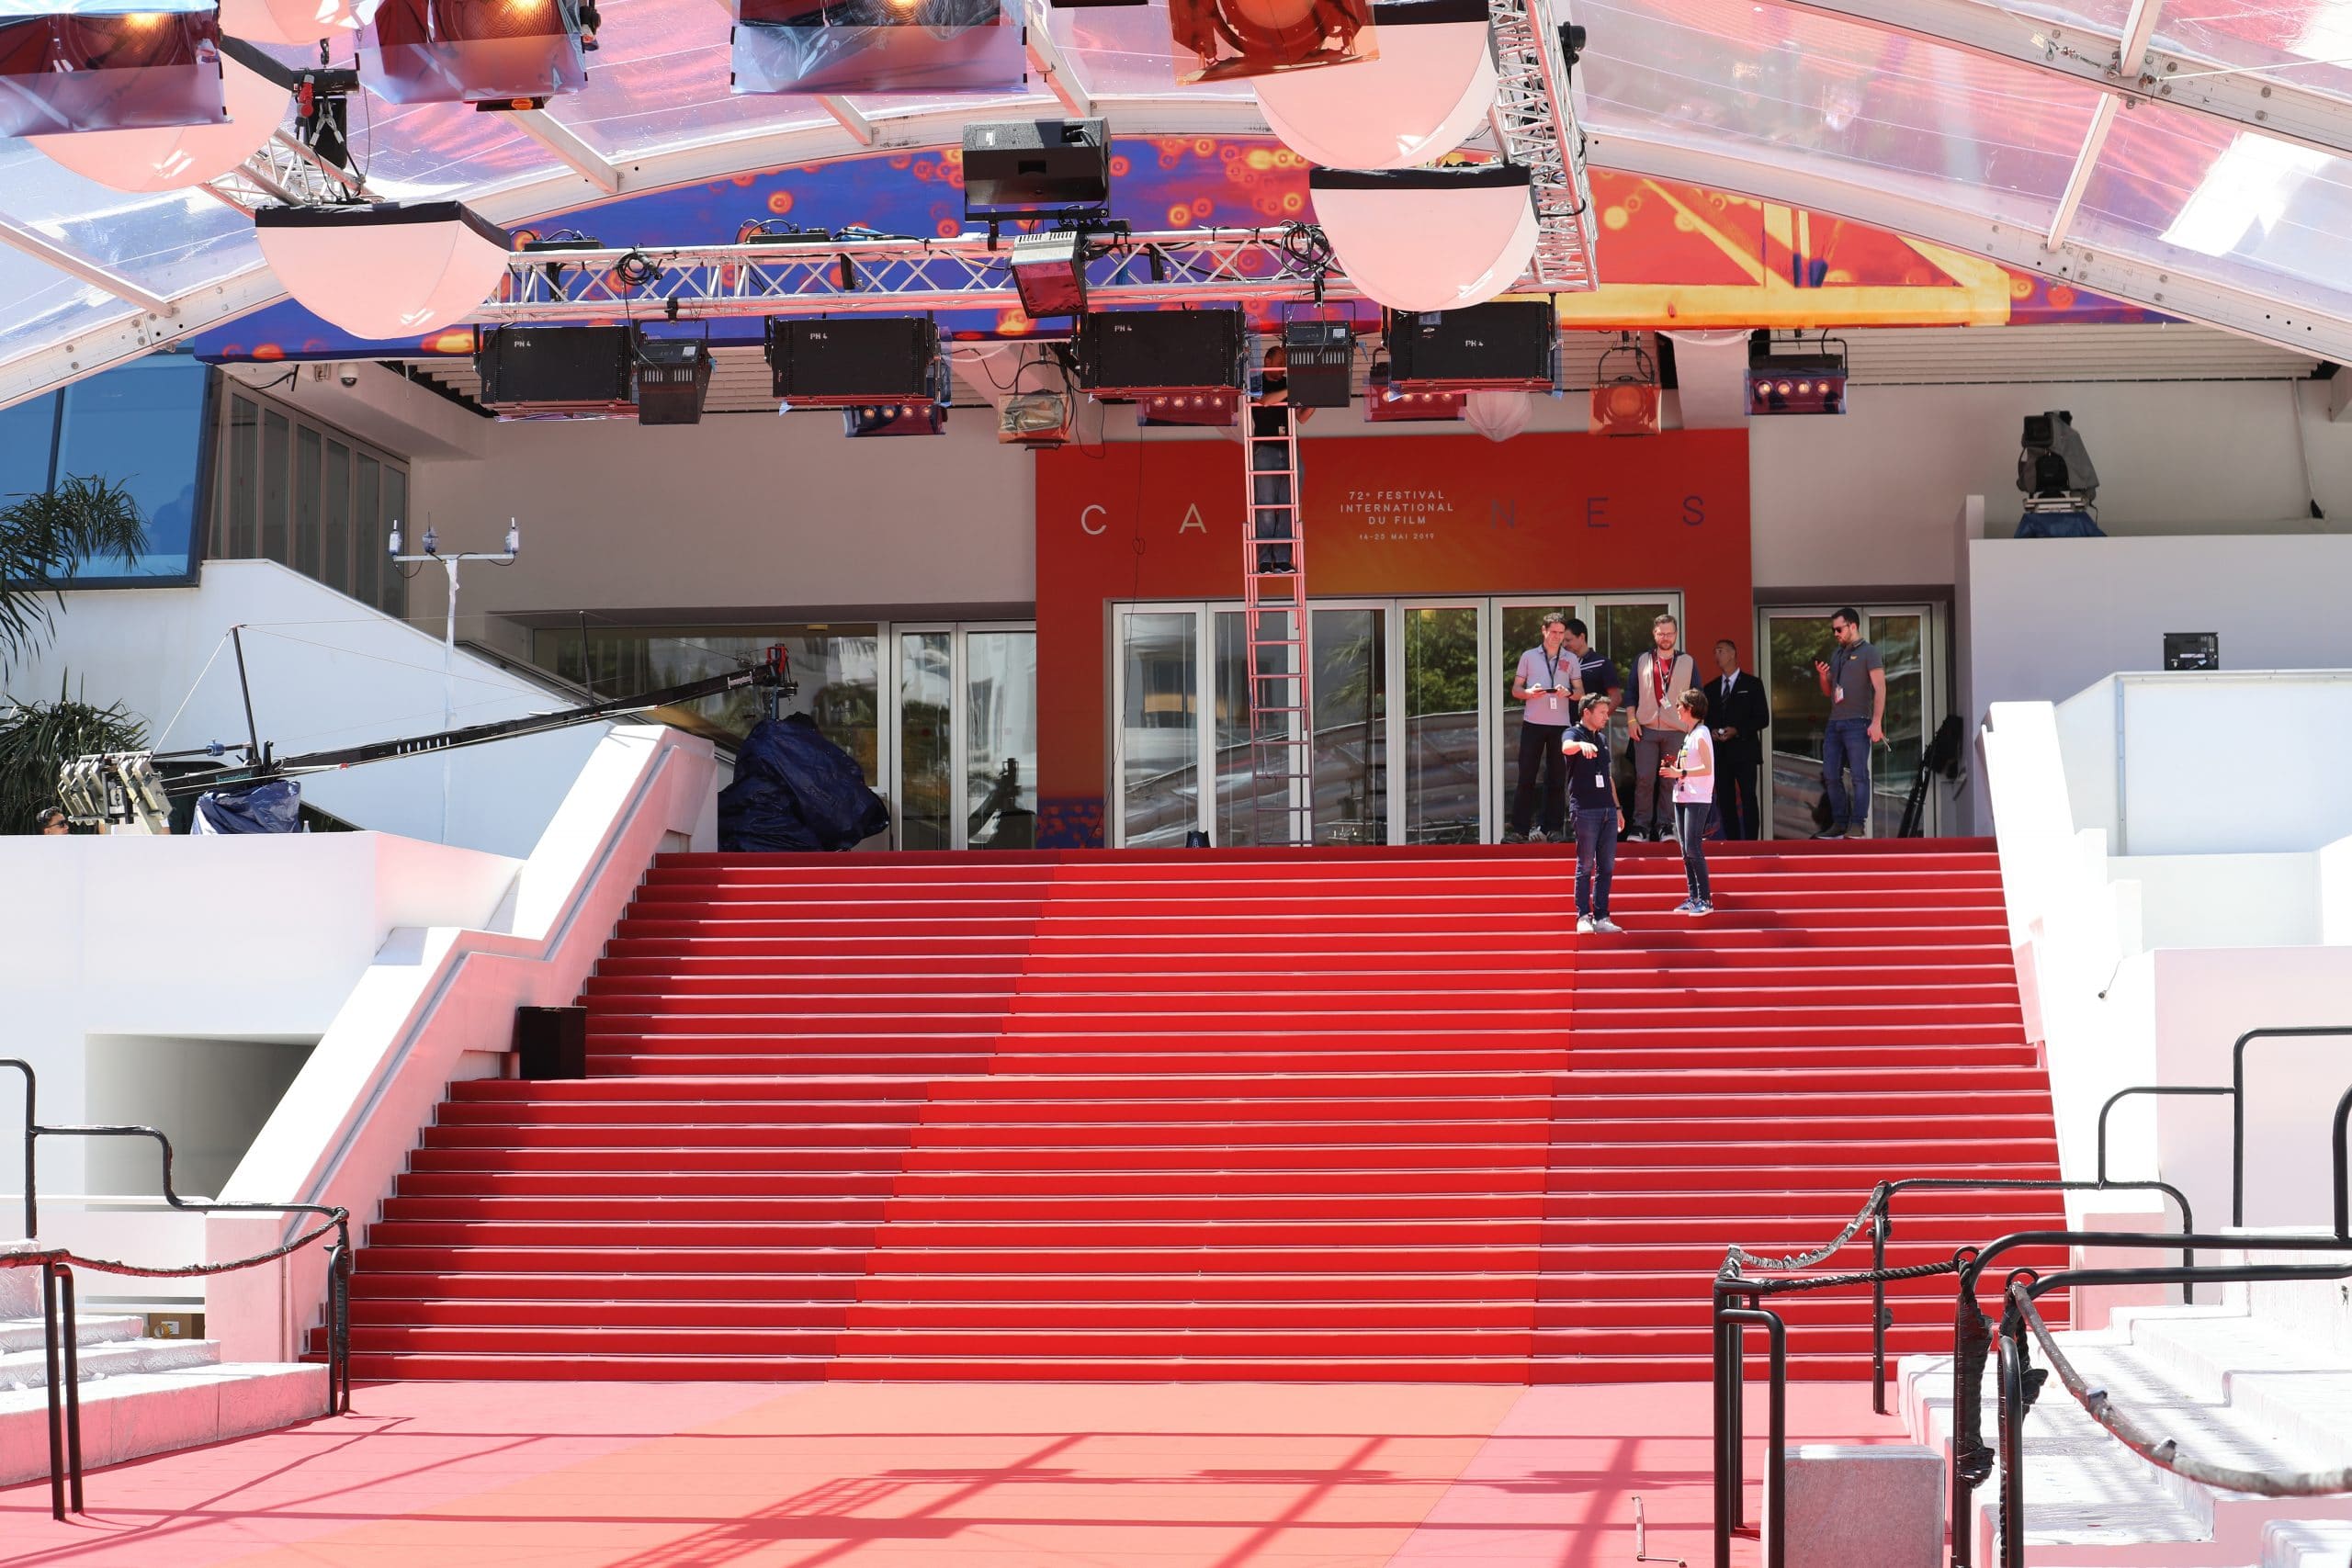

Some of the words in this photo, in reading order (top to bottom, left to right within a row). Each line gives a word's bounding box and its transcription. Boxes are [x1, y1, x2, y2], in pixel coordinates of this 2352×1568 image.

[1377, 491, 1444, 500] FESTIVAL
[1340, 502, 1453, 513] INTERNATIONAL
[1368, 515, 1385, 525] DU
[1394, 515, 1426, 525] FILM
[1413, 532, 1435, 540] 2019
